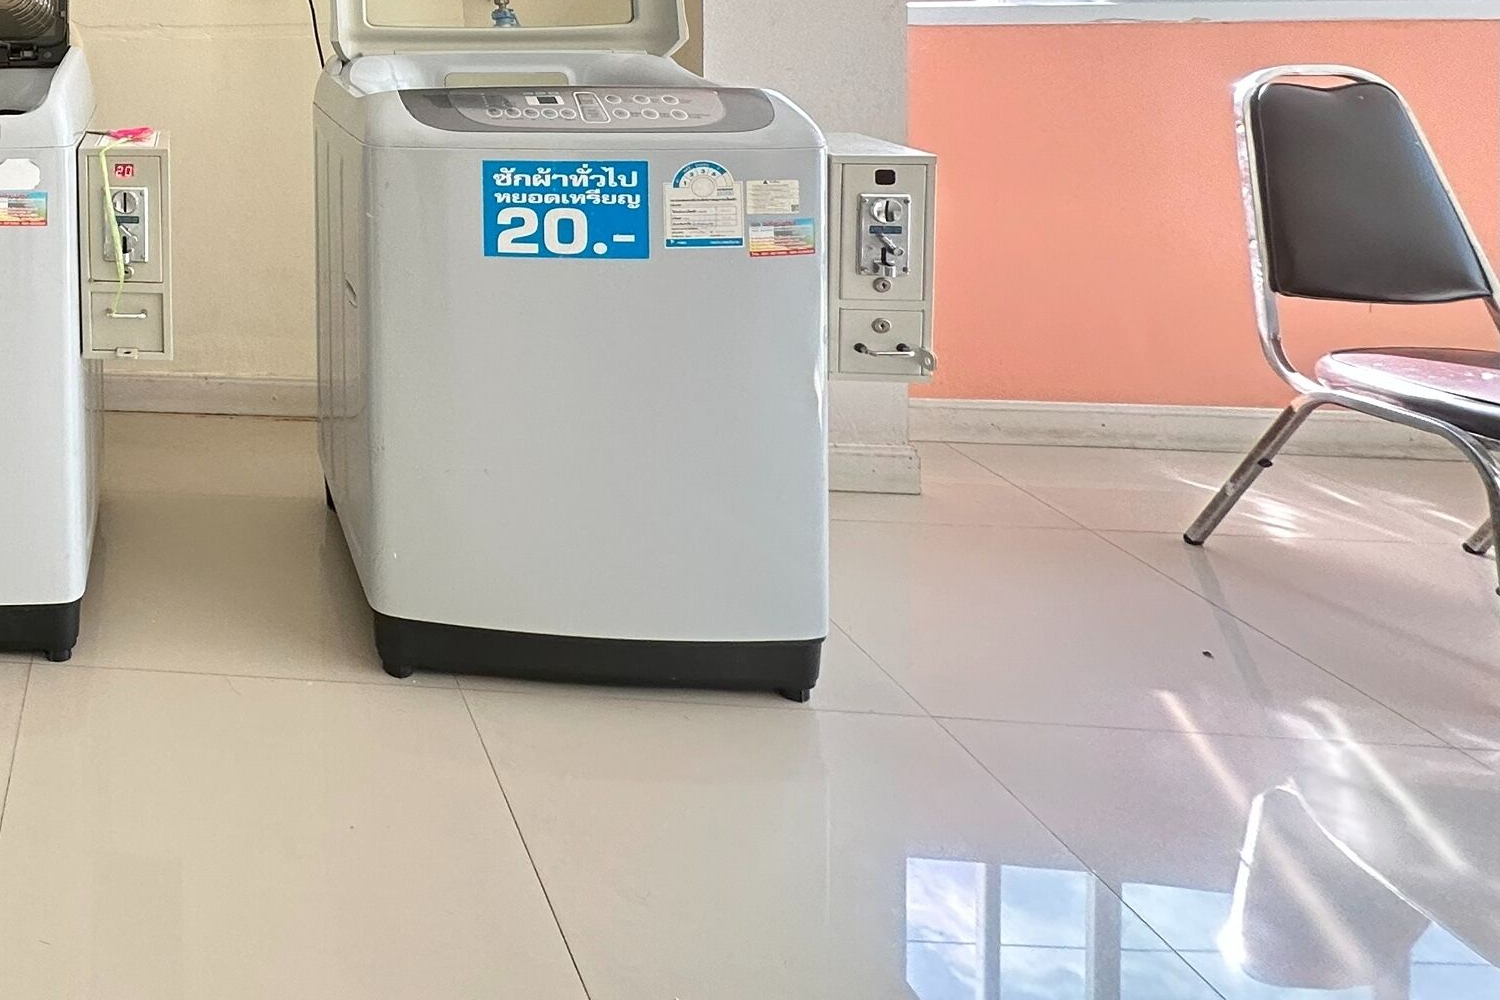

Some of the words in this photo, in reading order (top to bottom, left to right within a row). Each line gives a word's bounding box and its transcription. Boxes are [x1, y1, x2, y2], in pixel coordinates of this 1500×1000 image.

[115, 166, 133, 177] 20
[493, 163, 638, 188] ซักผ้าทั่วไป
[494, 189, 641, 209] หยอดเหรียญ
[497, 206, 636, 255] 20.-
